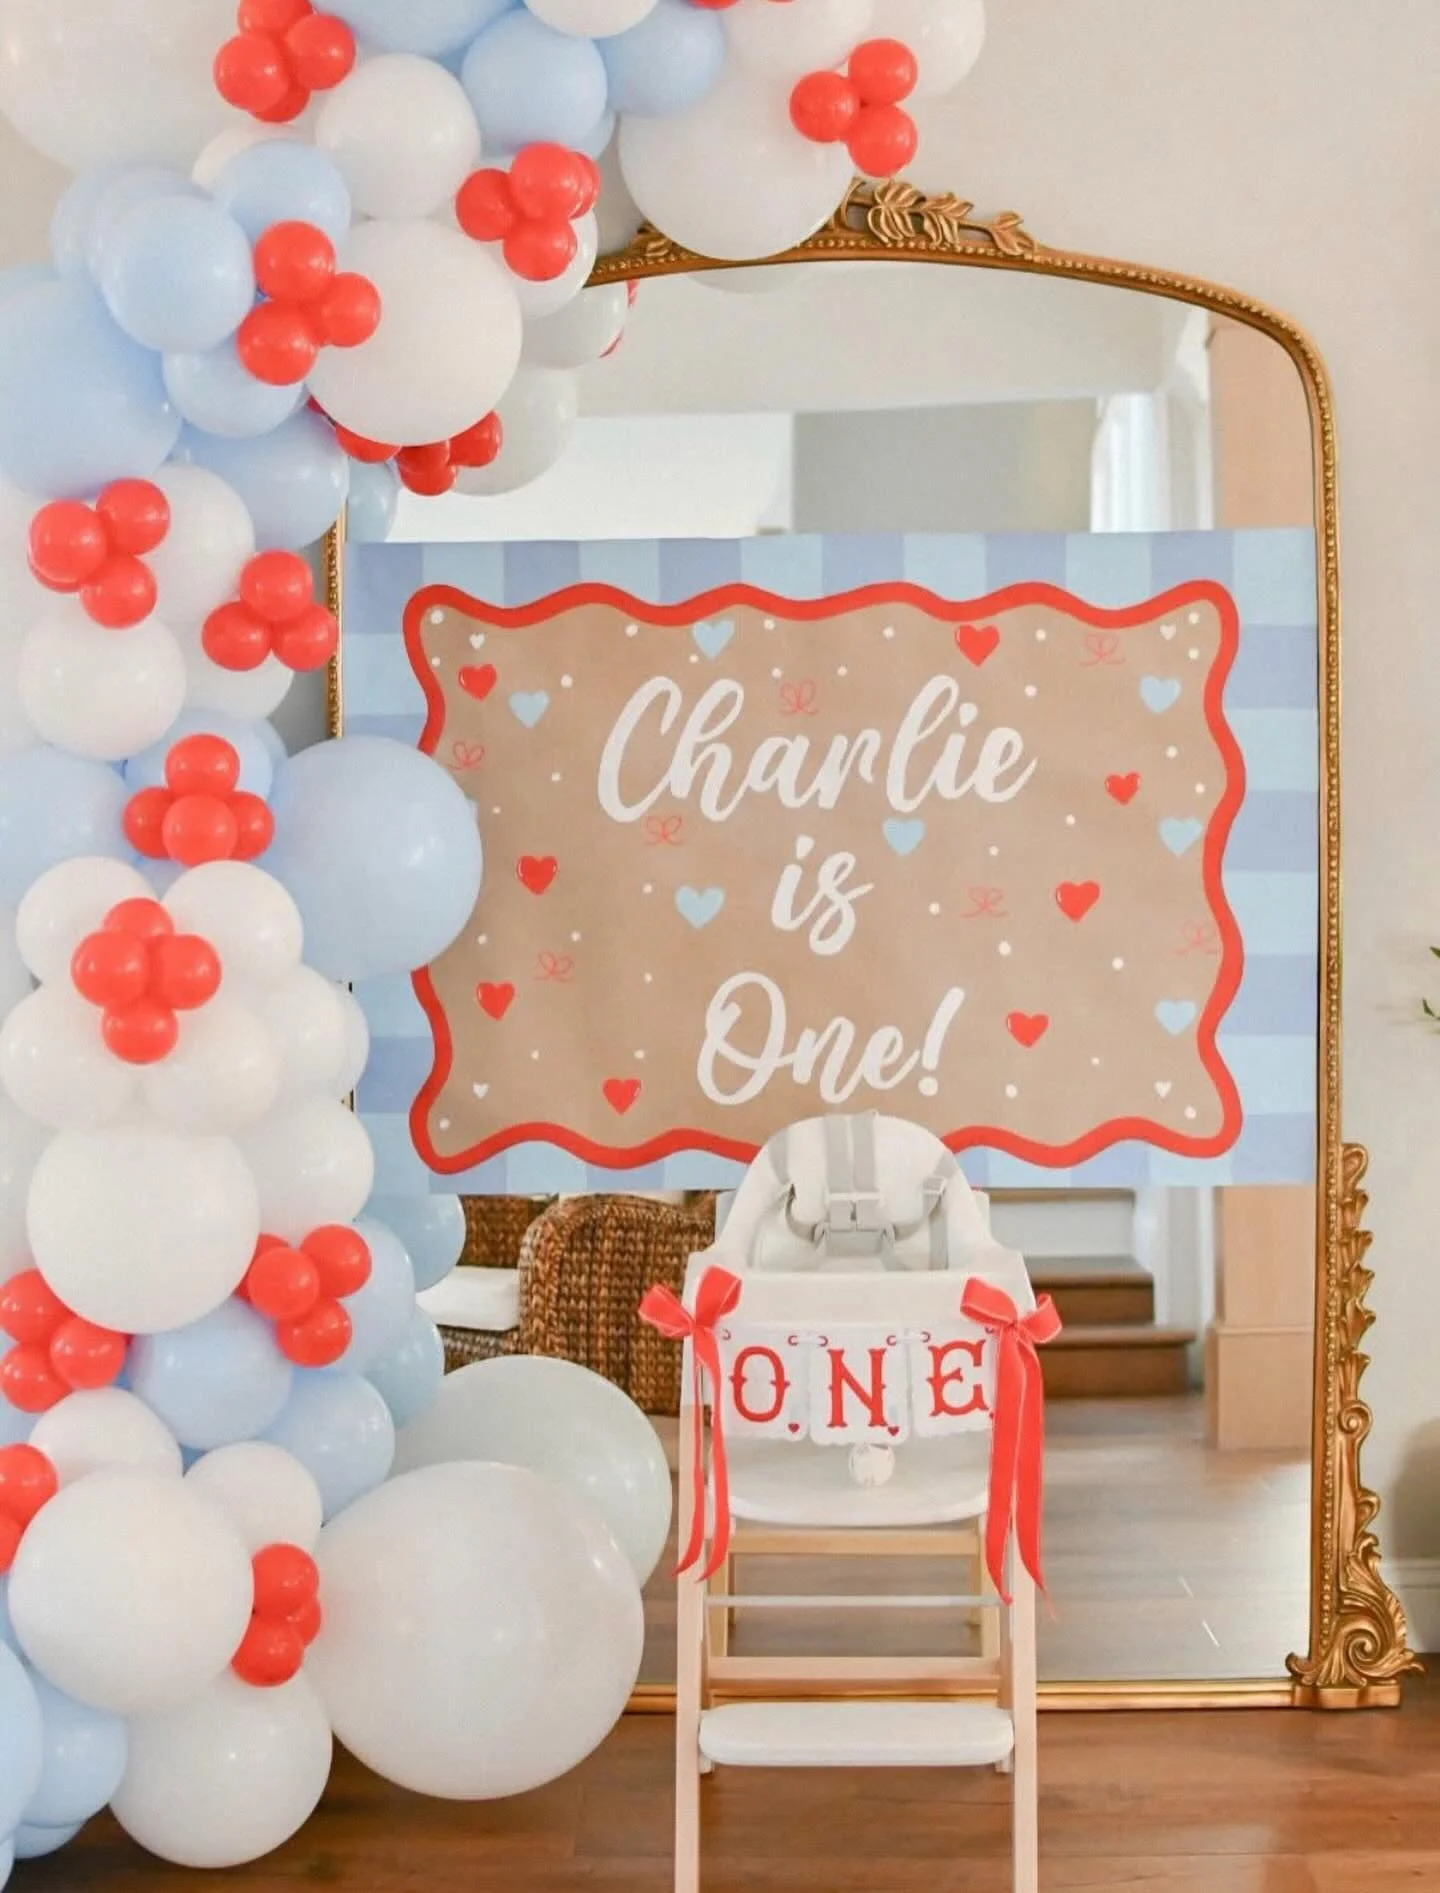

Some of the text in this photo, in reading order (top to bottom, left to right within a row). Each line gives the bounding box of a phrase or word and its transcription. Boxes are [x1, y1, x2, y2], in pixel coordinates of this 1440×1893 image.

[598, 675, 1037, 823] Charlie
[771, 834, 874, 955] is
[697, 972, 965, 1105] One!
[728, 1339, 994, 1428] ONE
